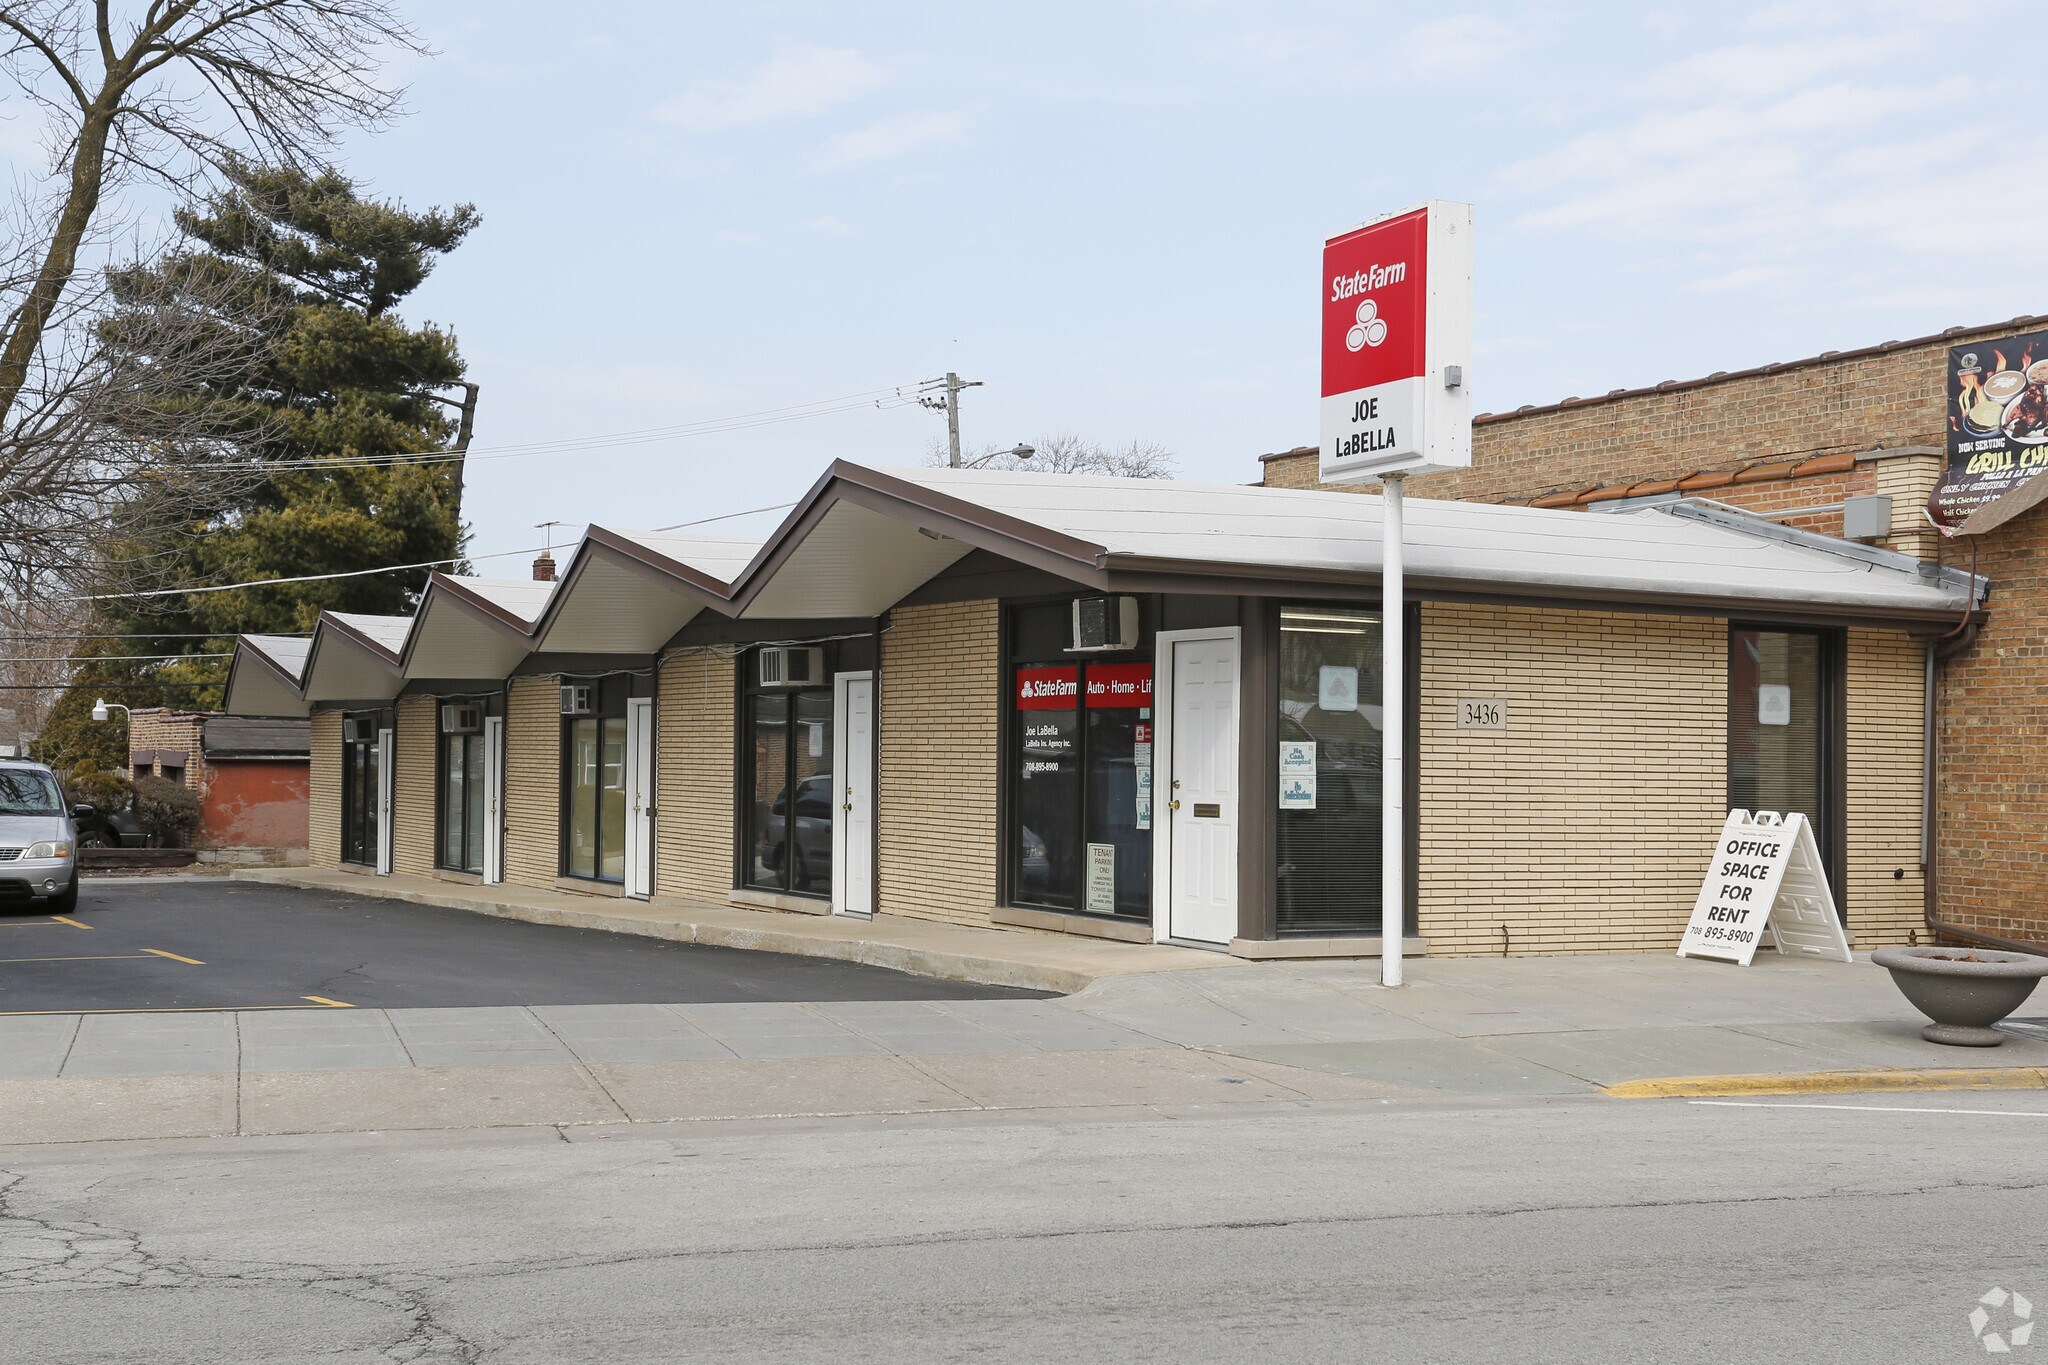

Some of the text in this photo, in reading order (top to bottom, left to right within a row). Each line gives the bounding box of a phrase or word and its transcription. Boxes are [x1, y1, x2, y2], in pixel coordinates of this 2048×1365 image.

[1351, 397, 1379, 423] JOE
[1336, 426, 1396, 458] LaBELLA
[1958, 438, 2006, 453] NOW SERVING
[1965, 450, 2016, 475] GRILL
[1969, 480, 2011, 491] CHICKEN
[1956, 495, 1980, 505] Chicken
[1087, 681, 1105, 694] Auto
[1111, 679, 1135, 694] Home
[1465, 703, 1499, 725] 3436
[1026, 724, 1058, 736] Joe LaBella
[1048, 740, 1063, 748] Agency
[1025, 762, 1059, 771] 708-895-8900
[1726, 839, 1780, 858] OFFICE
[1720, 862, 1770, 880] SPACE
[1720, 884, 1753, 901] FOR
[1707, 905, 1750, 924] RENT
[1690, 926, 1754, 943] 708 895-8900
